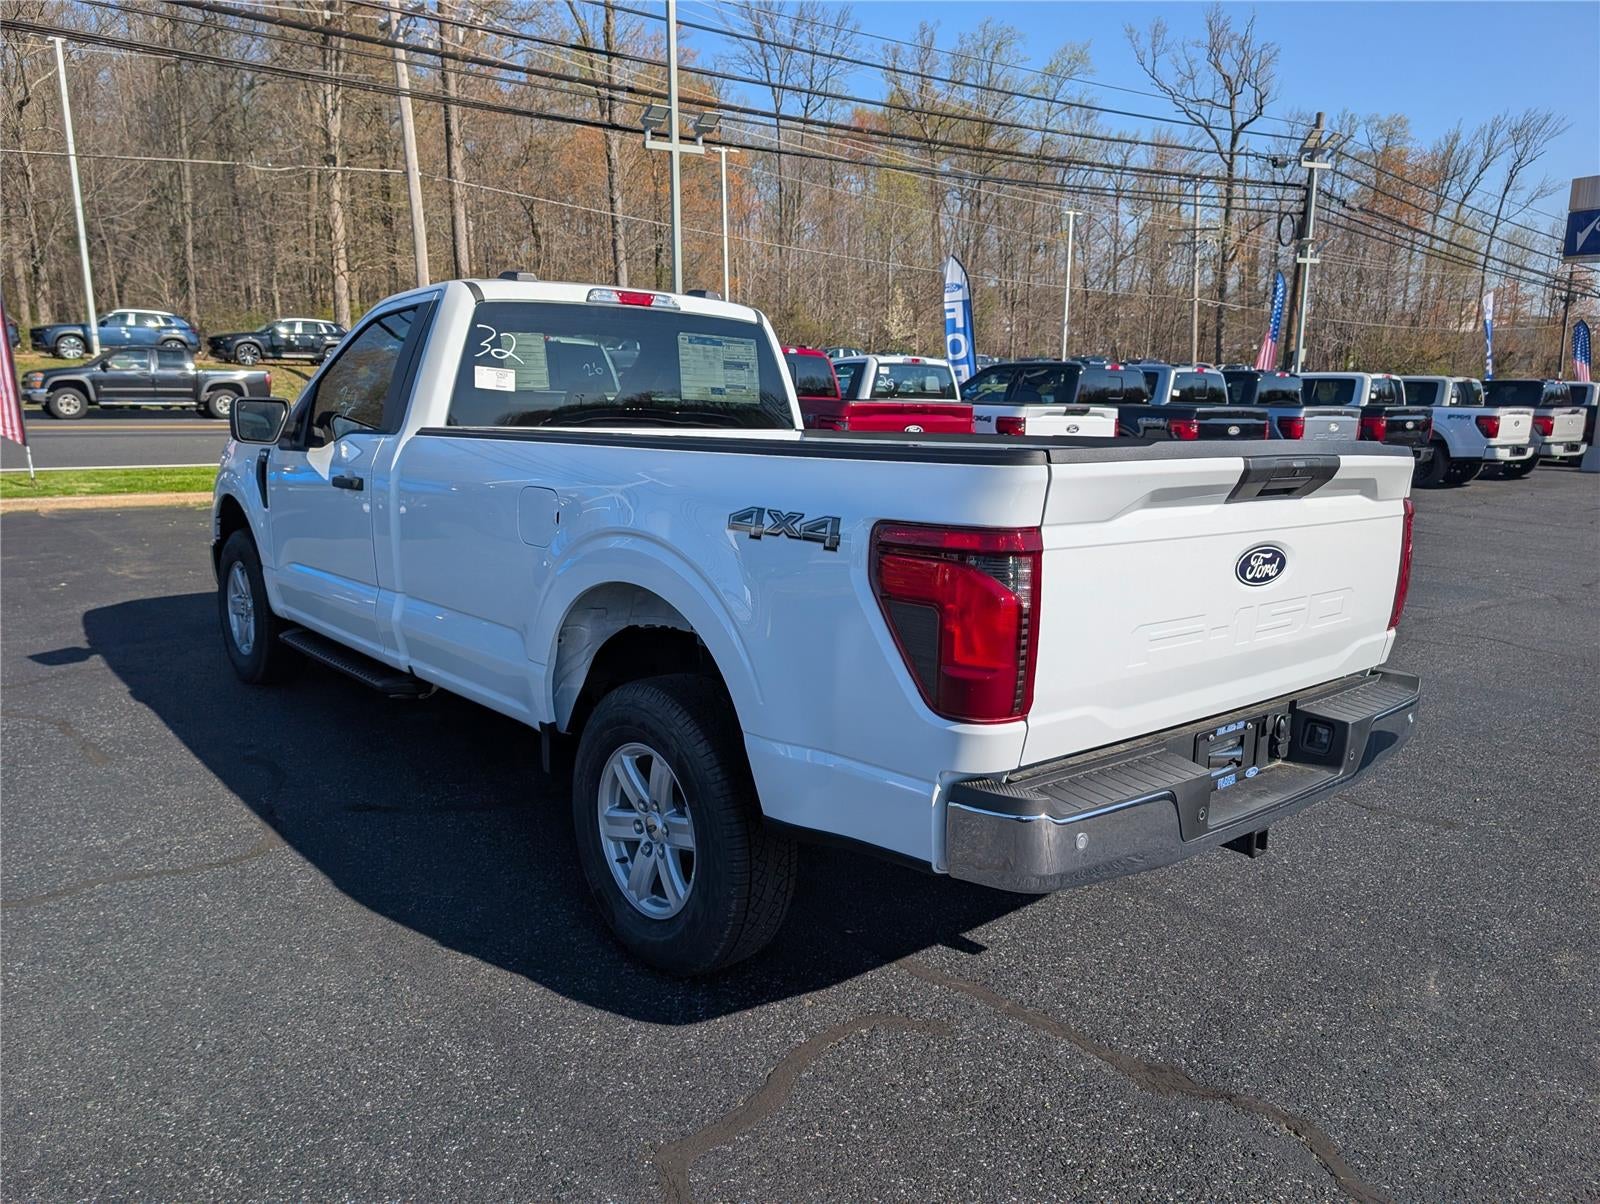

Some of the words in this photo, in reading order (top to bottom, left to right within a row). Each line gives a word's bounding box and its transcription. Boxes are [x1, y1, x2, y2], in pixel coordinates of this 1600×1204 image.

[474, 324, 525, 365] 32
[1245, 551, 1281, 580] Ford
[1126, 586, 1355, 669] F-150
